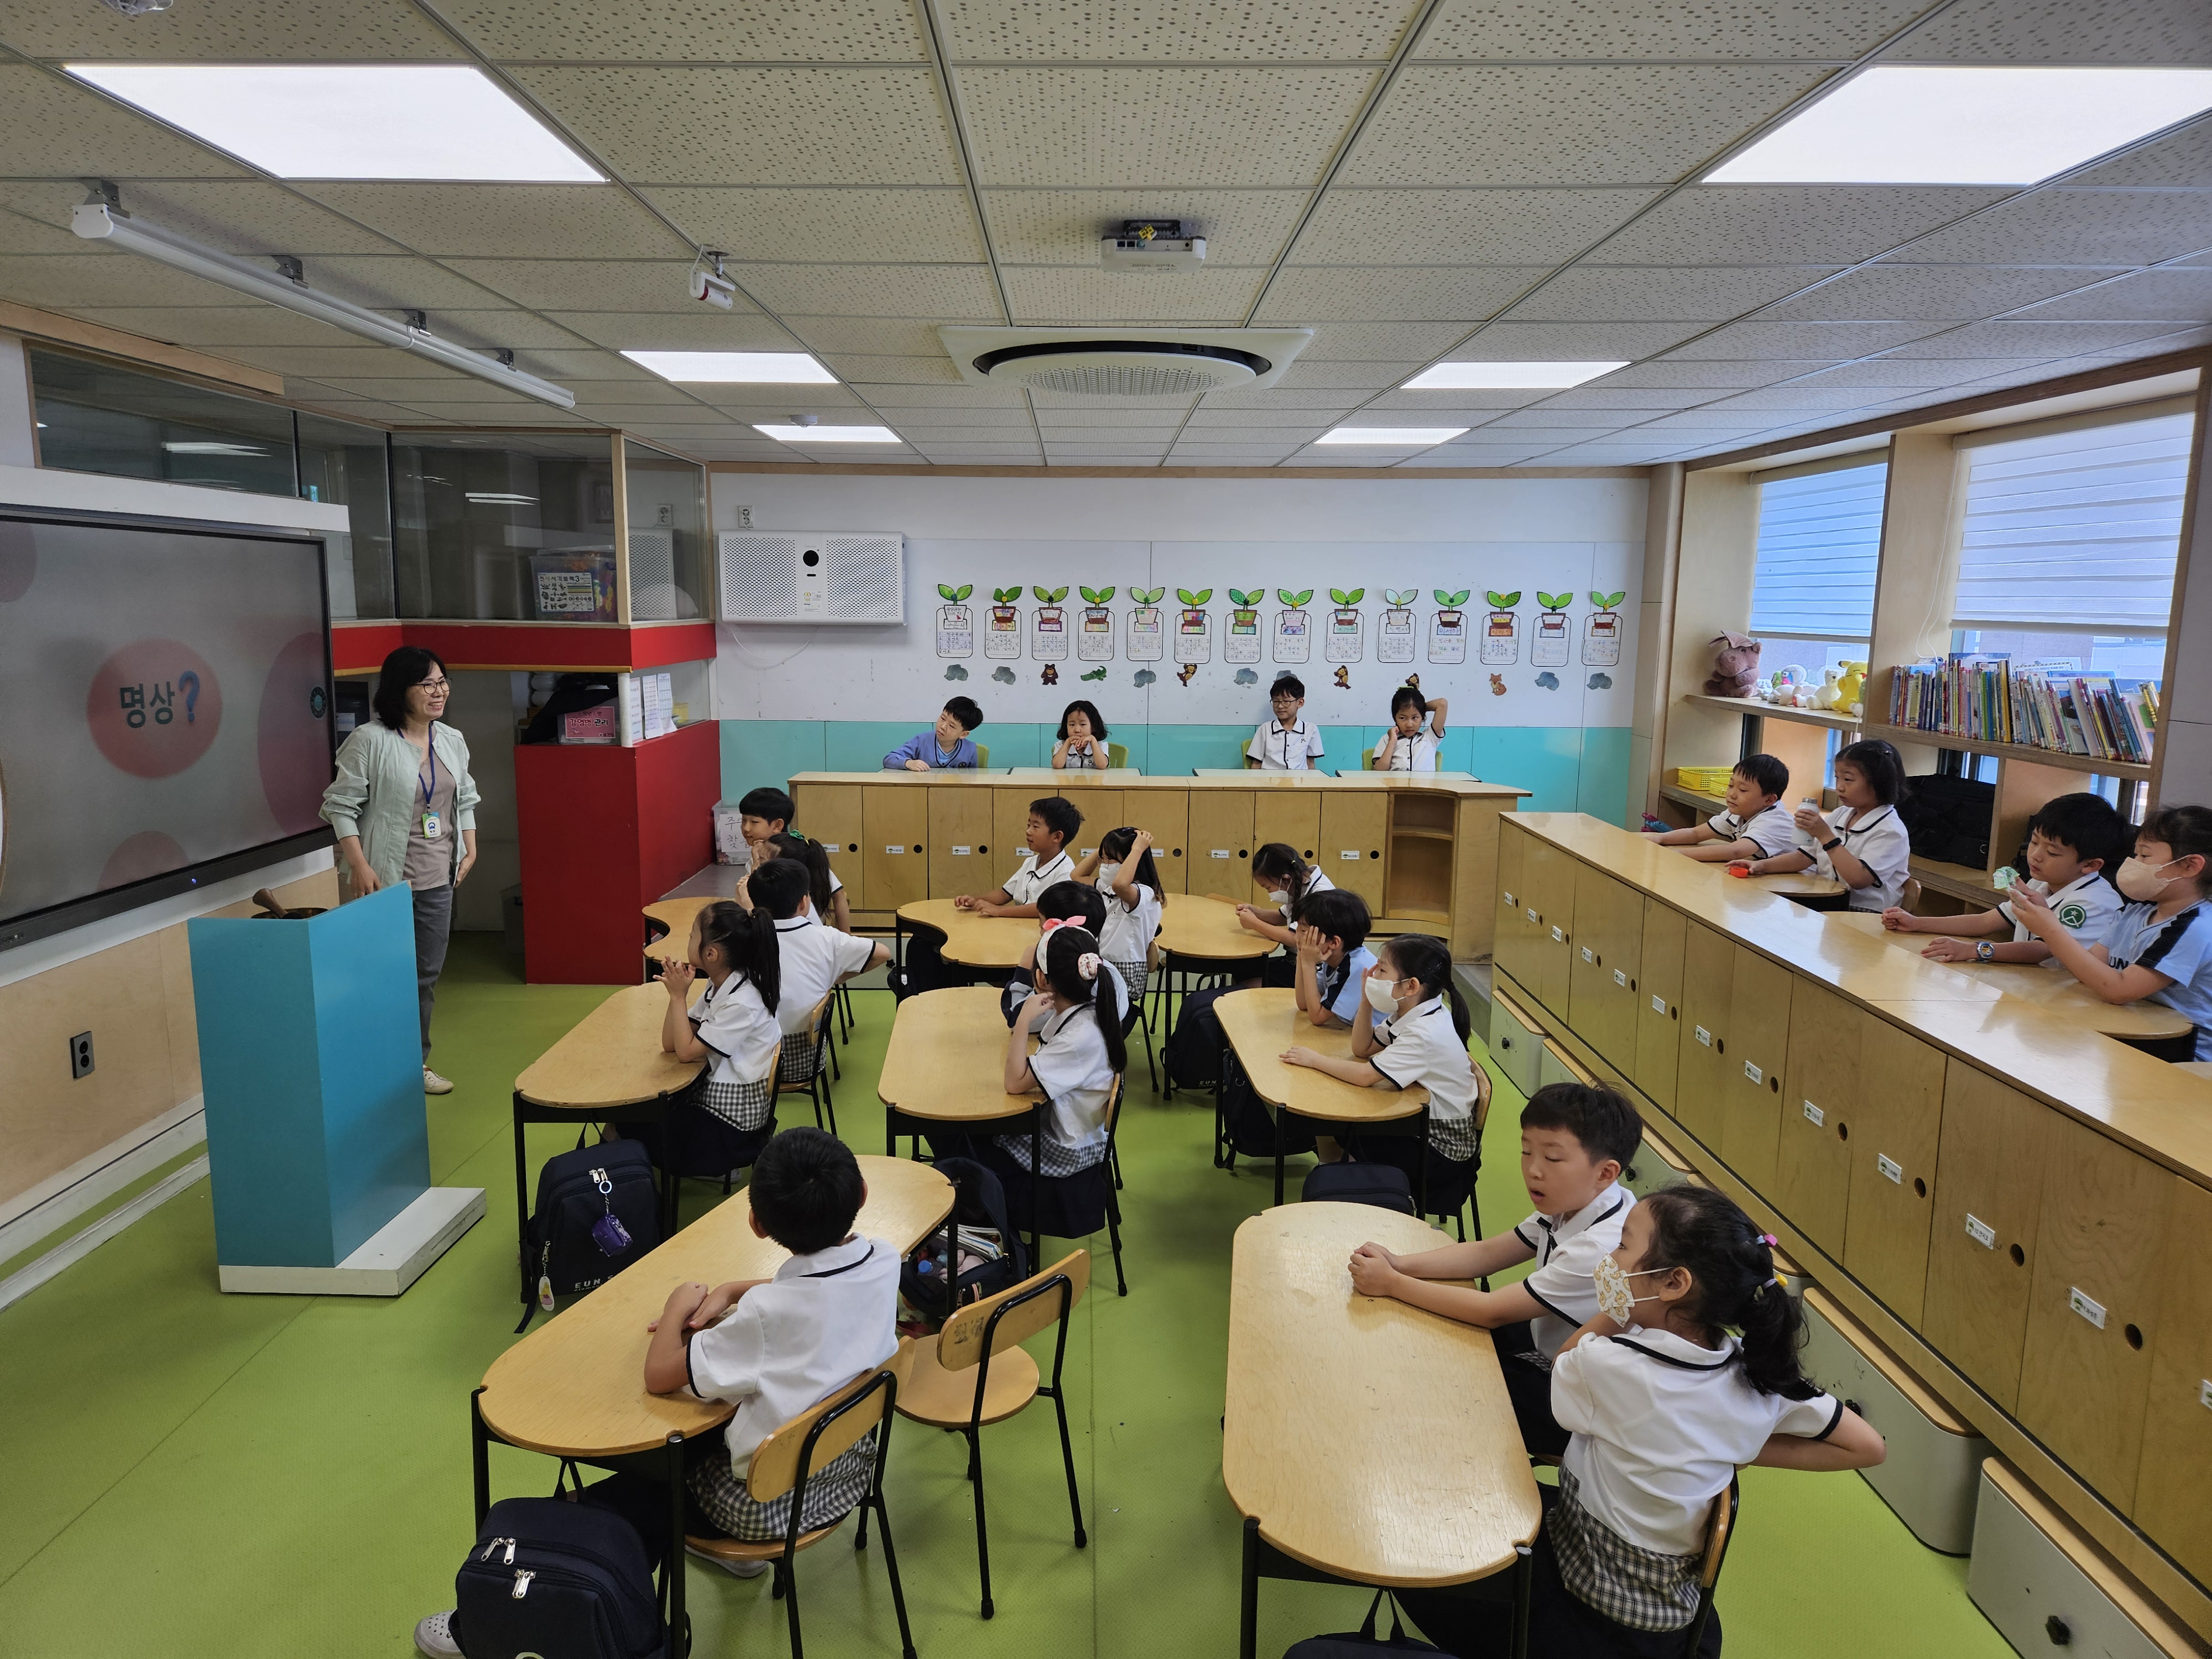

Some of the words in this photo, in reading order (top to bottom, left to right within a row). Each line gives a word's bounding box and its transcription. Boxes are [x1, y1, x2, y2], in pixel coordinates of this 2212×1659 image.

[120, 670, 201, 729] 명상?
[569, 718, 592, 727] 감염병
[594, 718, 608, 727] 관리
[575, 1278, 601, 1288] EUN
